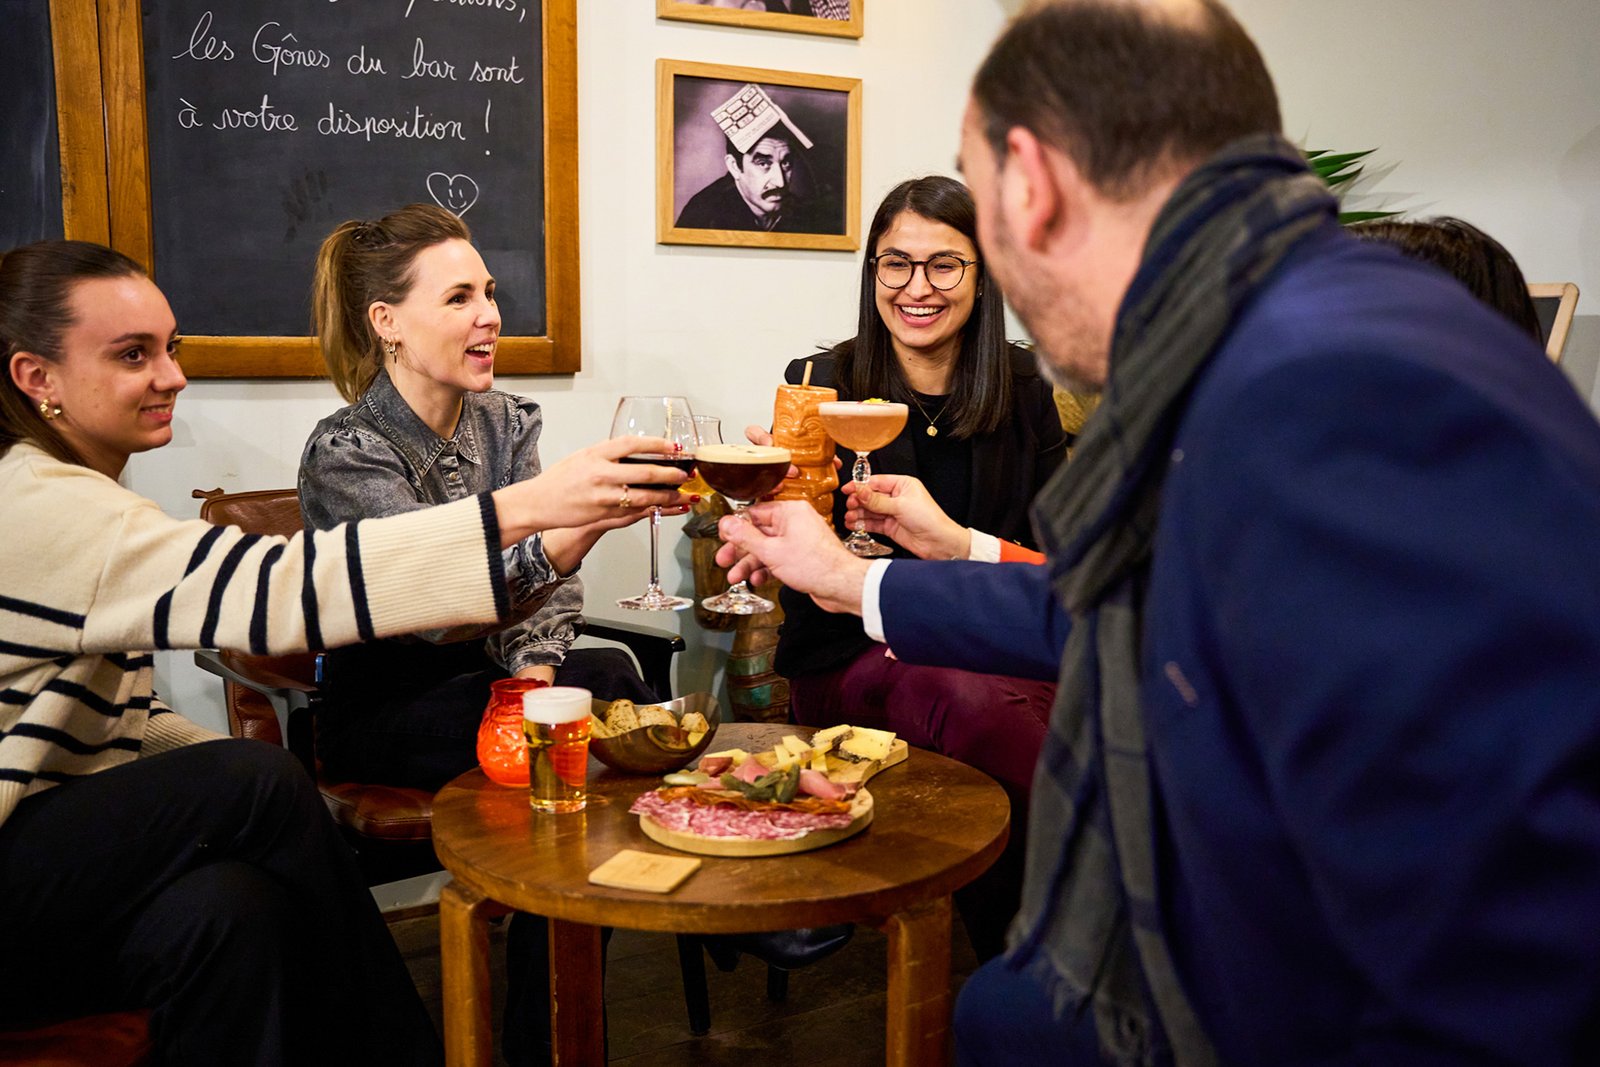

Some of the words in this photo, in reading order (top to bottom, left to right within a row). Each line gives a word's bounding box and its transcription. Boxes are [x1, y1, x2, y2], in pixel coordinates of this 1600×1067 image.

[172, 10, 235, 61] les
[252, 21, 331, 76] Gônes
[346, 44, 388, 75] du
[400, 37, 458, 81] bar
[468, 55, 525, 84] sont
[178, 97, 203, 129] à
[212, 93, 299, 132] votre
[317, 101, 467, 142] disposition
